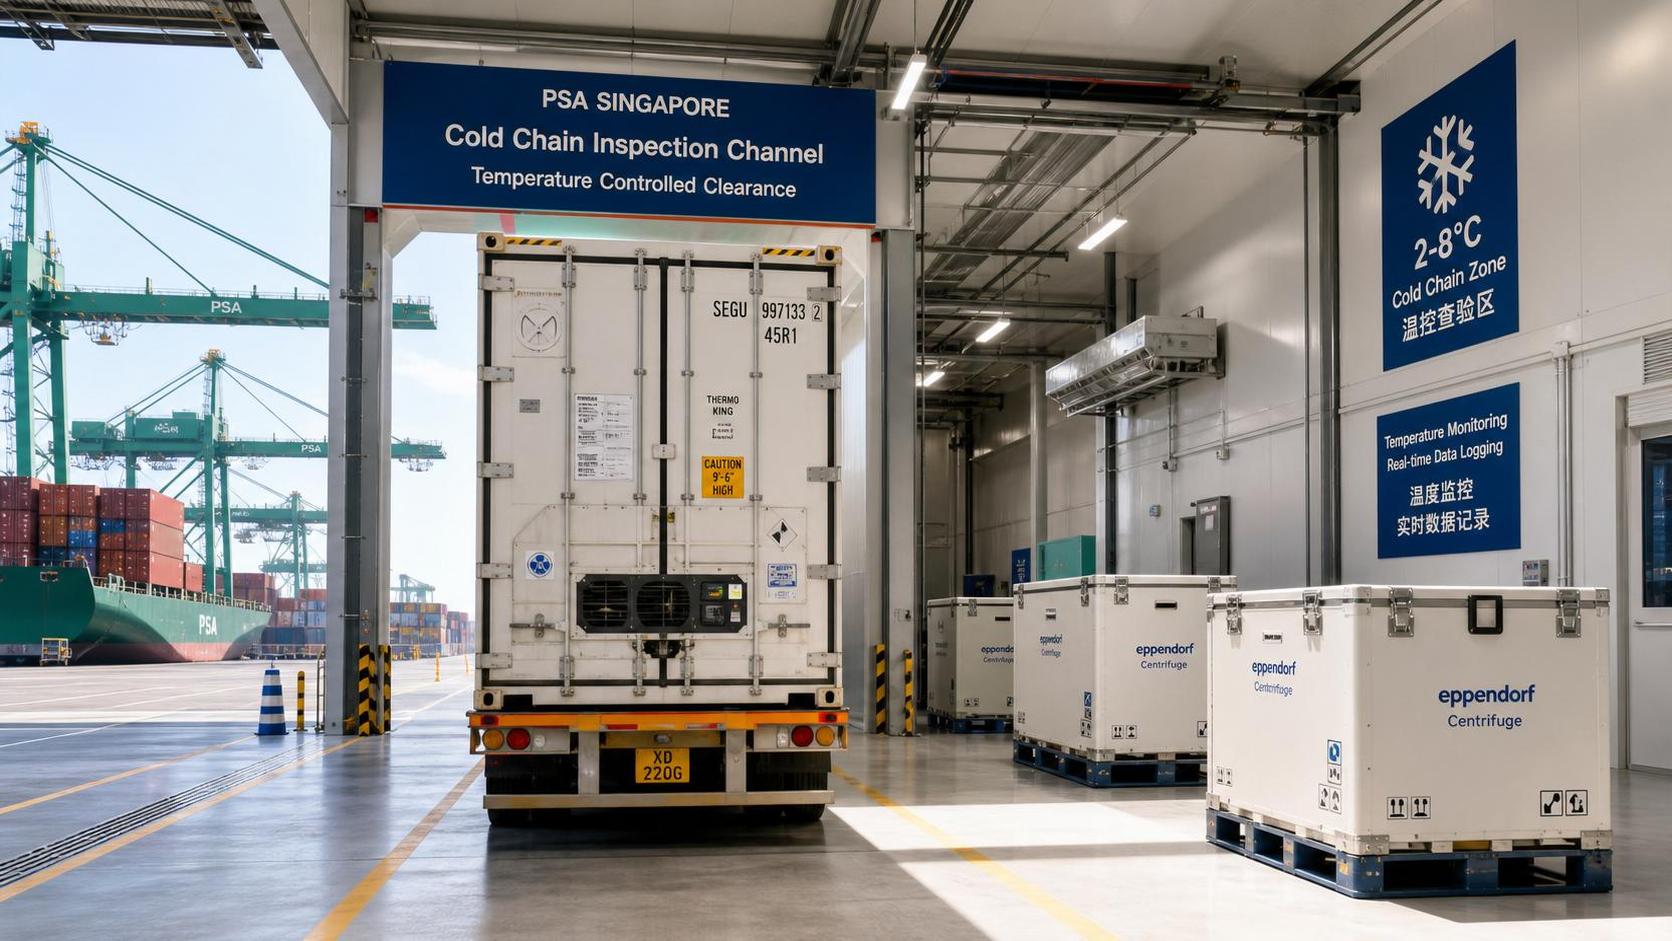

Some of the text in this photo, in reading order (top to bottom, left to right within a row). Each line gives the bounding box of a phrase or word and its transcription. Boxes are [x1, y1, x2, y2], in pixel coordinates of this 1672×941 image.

[542, 88, 730, 118] PSA SINGAPORE
[445, 123, 823, 164] Cold Chain Inspection Channel
[471, 166, 796, 198] Temperature Controlled Clearance
[1414, 214, 1482, 271] 2-8°C
[1392, 255, 1507, 309] Cold Chain Zone
[211, 301, 242, 314] PSA
[713, 300, 821, 321] SEGU 997133 2
[1402, 288, 1495, 342] 温控查验区
[764, 326, 797, 344] 45R1
[707, 395, 739, 404] THERMO
[712, 406, 734, 416] KING
[1384, 413, 1508, 449] Temperature Monitoring
[301, 444, 322, 453] PSA
[1387, 440, 1503, 472] Real-time Data Logging
[704, 459, 742, 470] CAUTION
[712, 485, 734, 496] HIGH
[1409, 477, 1474, 507] 温度监控
[1397, 507, 1490, 537] 实时数据记录
[199, 613, 218, 636] PSA
[1136, 643, 1194, 657] eppendorf
[1140, 660, 1188, 671] Centrifuge
[1252, 660, 1296, 676] eppendorf
[1438, 684, 1535, 708] eppendorf
[1448, 714, 1522, 730] Centrifuge
[653, 750, 672, 764] XD
[643, 766, 682, 780] 220G
